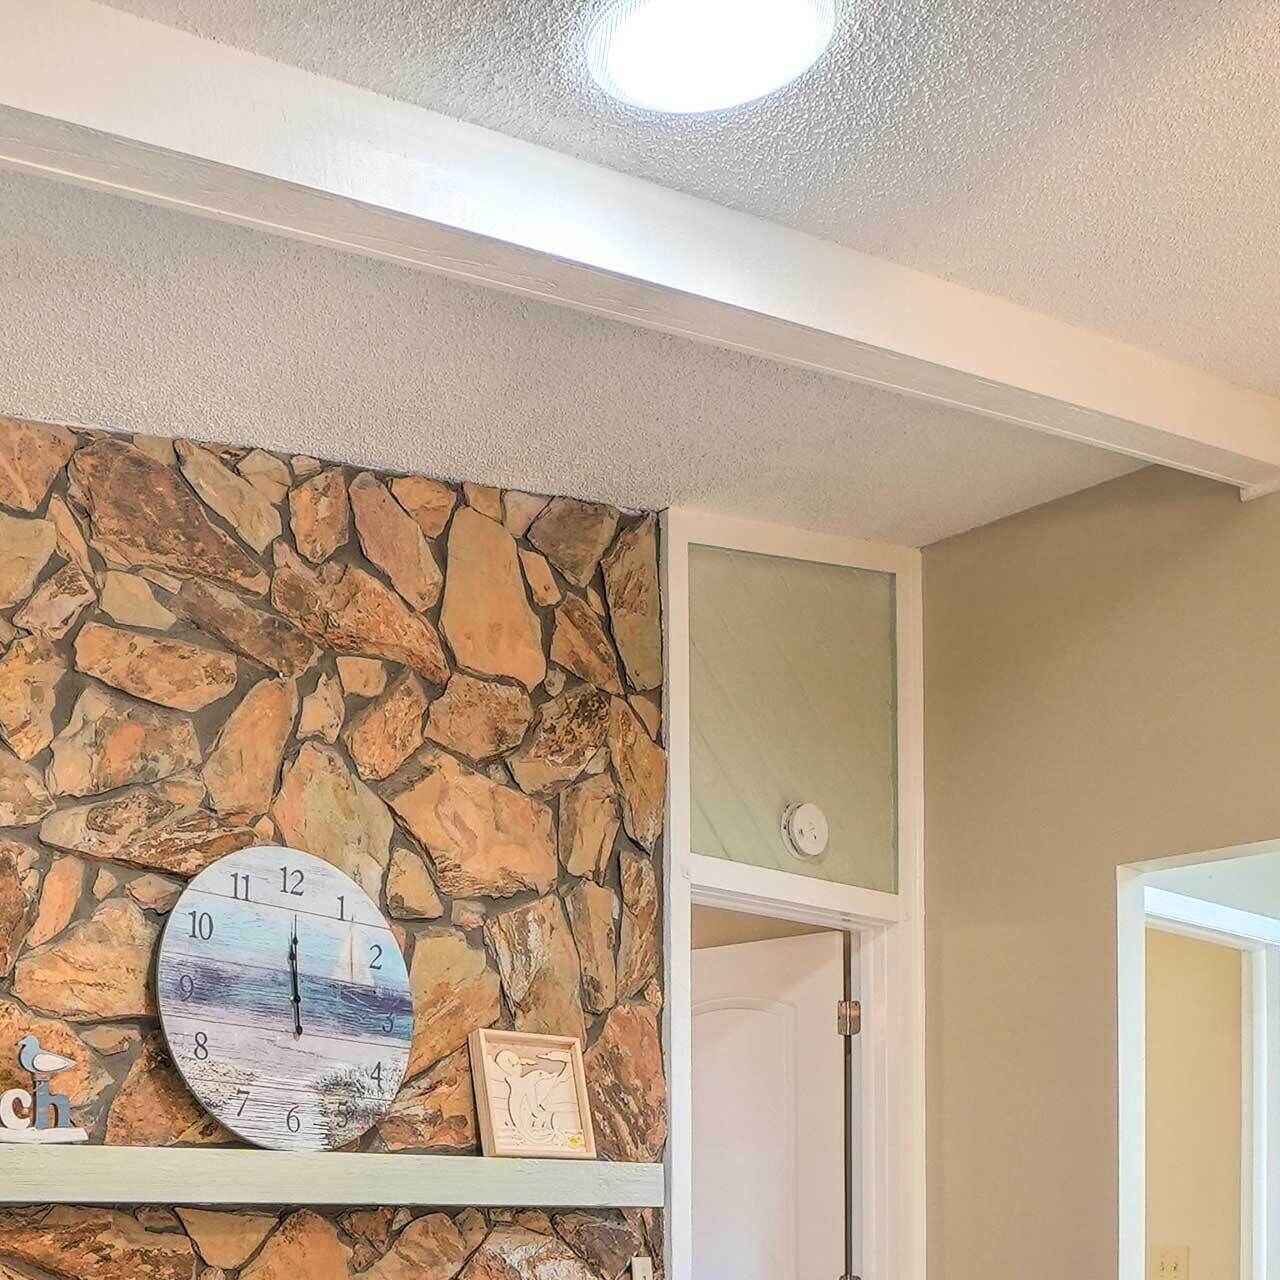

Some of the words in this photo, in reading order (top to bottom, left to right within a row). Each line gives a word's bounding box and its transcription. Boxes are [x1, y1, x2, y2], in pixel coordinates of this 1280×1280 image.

[229, 872, 251, 902] 11
[279, 866, 305, 897] 12
[336, 895, 346, 921] 1
[187, 910, 214, 941] 10
[369, 944, 383, 970] 2
[179, 974, 195, 1001] 9
[194, 1031, 210, 1061] 8
[369, 1061, 384, 1095] 4
[234, 1089, 251, 1117] 7
[285, 1105, 300, 1133] 6
